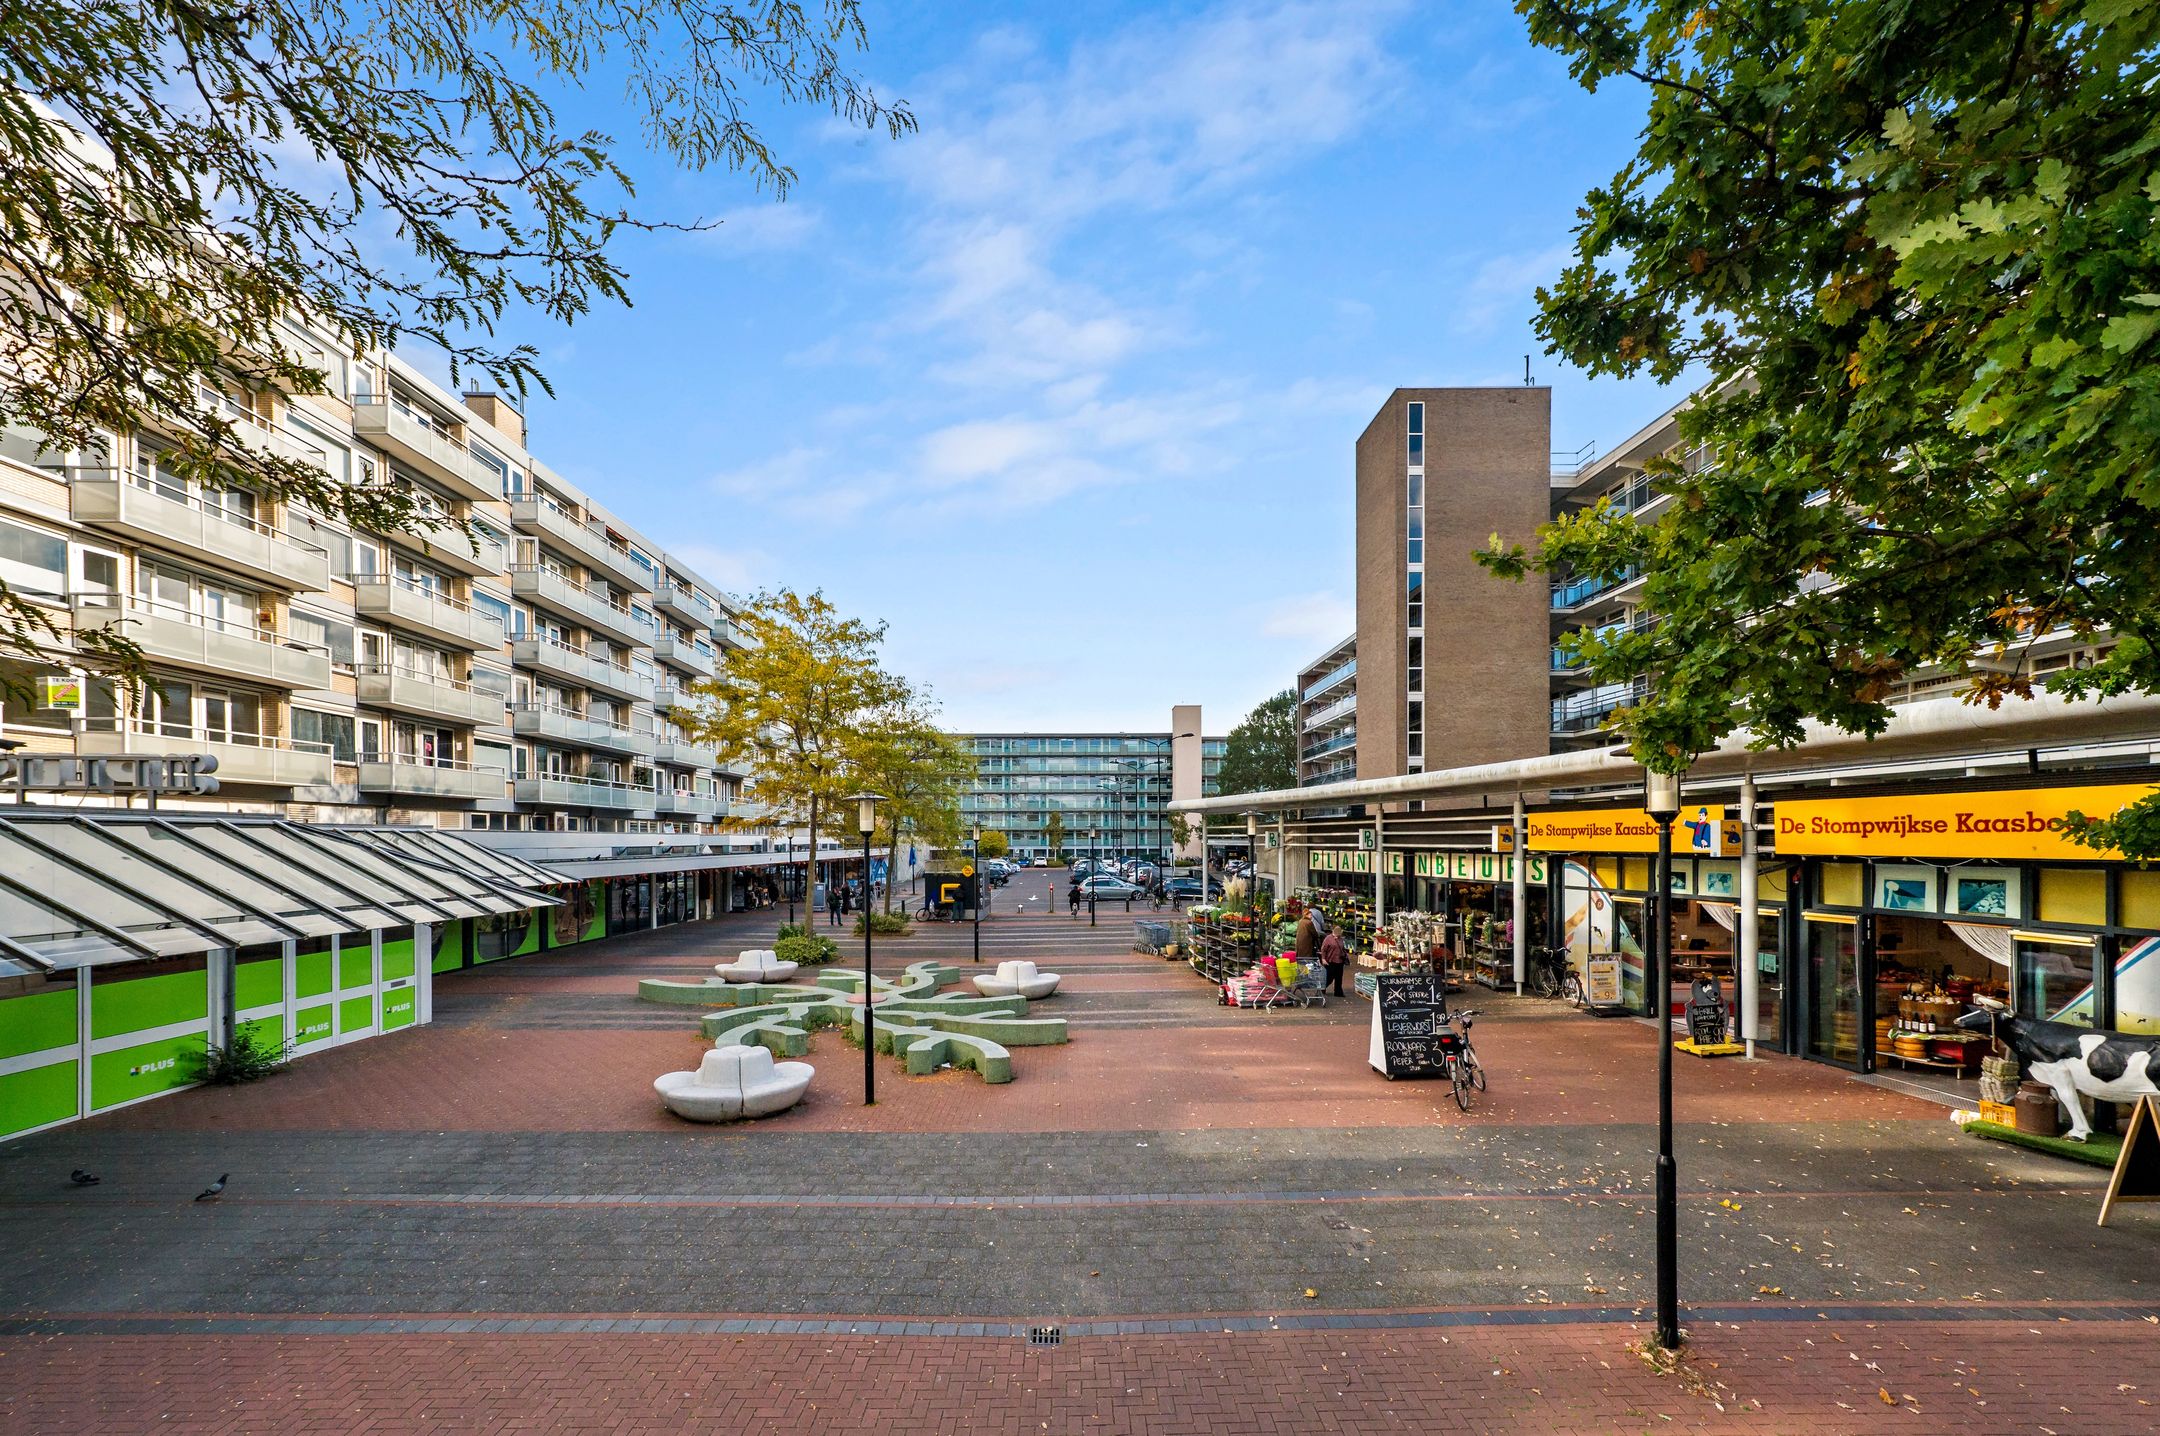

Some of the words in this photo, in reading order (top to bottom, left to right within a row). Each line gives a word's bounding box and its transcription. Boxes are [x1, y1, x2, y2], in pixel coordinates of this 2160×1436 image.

[1531, 824, 1544, 837] De
[1546, 823, 1613, 839] Stompwijkse
[1615, 821, 1676, 836] Kaasbor
[1779, 818, 1806, 834] De
[1811, 815, 1949, 838] Stompwijkse
[1955, 811, 2098, 833] Kaasbo
[391, 1002, 411, 1013] PLUS
[305, 1022, 330, 1035] PLUS
[141, 1058, 175, 1074] PLUS
